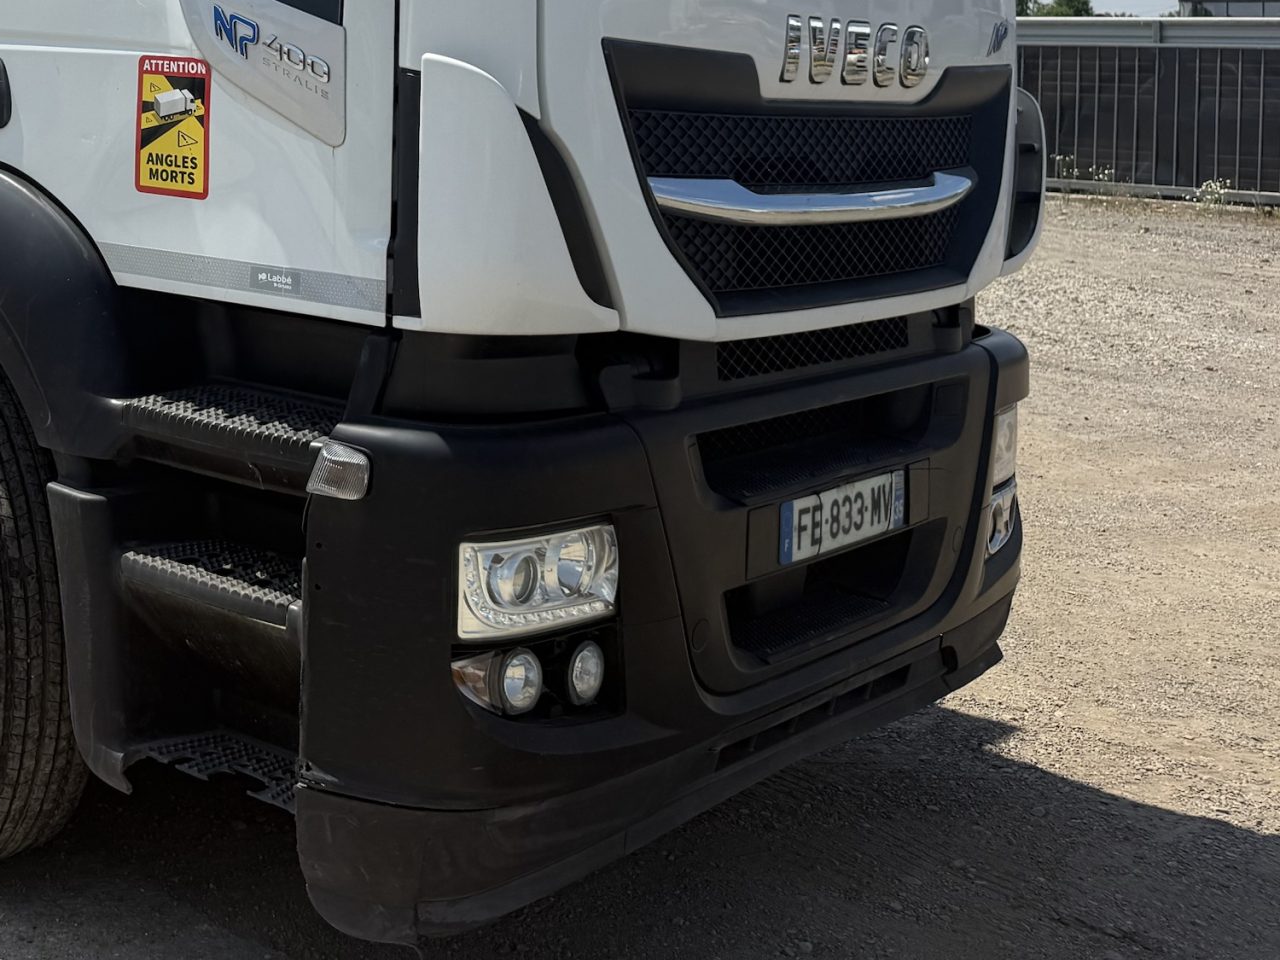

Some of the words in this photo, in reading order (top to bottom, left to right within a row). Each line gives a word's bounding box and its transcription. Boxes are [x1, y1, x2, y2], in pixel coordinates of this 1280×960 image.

[213, 4, 260, 60] NP
[261, 33, 331, 84] 400
[779, 13, 930, 88] IVECO
[143, 59, 207, 75] ATTENTION
[262, 57, 330, 101] STRALIS
[146, 152, 199, 170] ANGLES
[148, 168, 196, 186] MORTS
